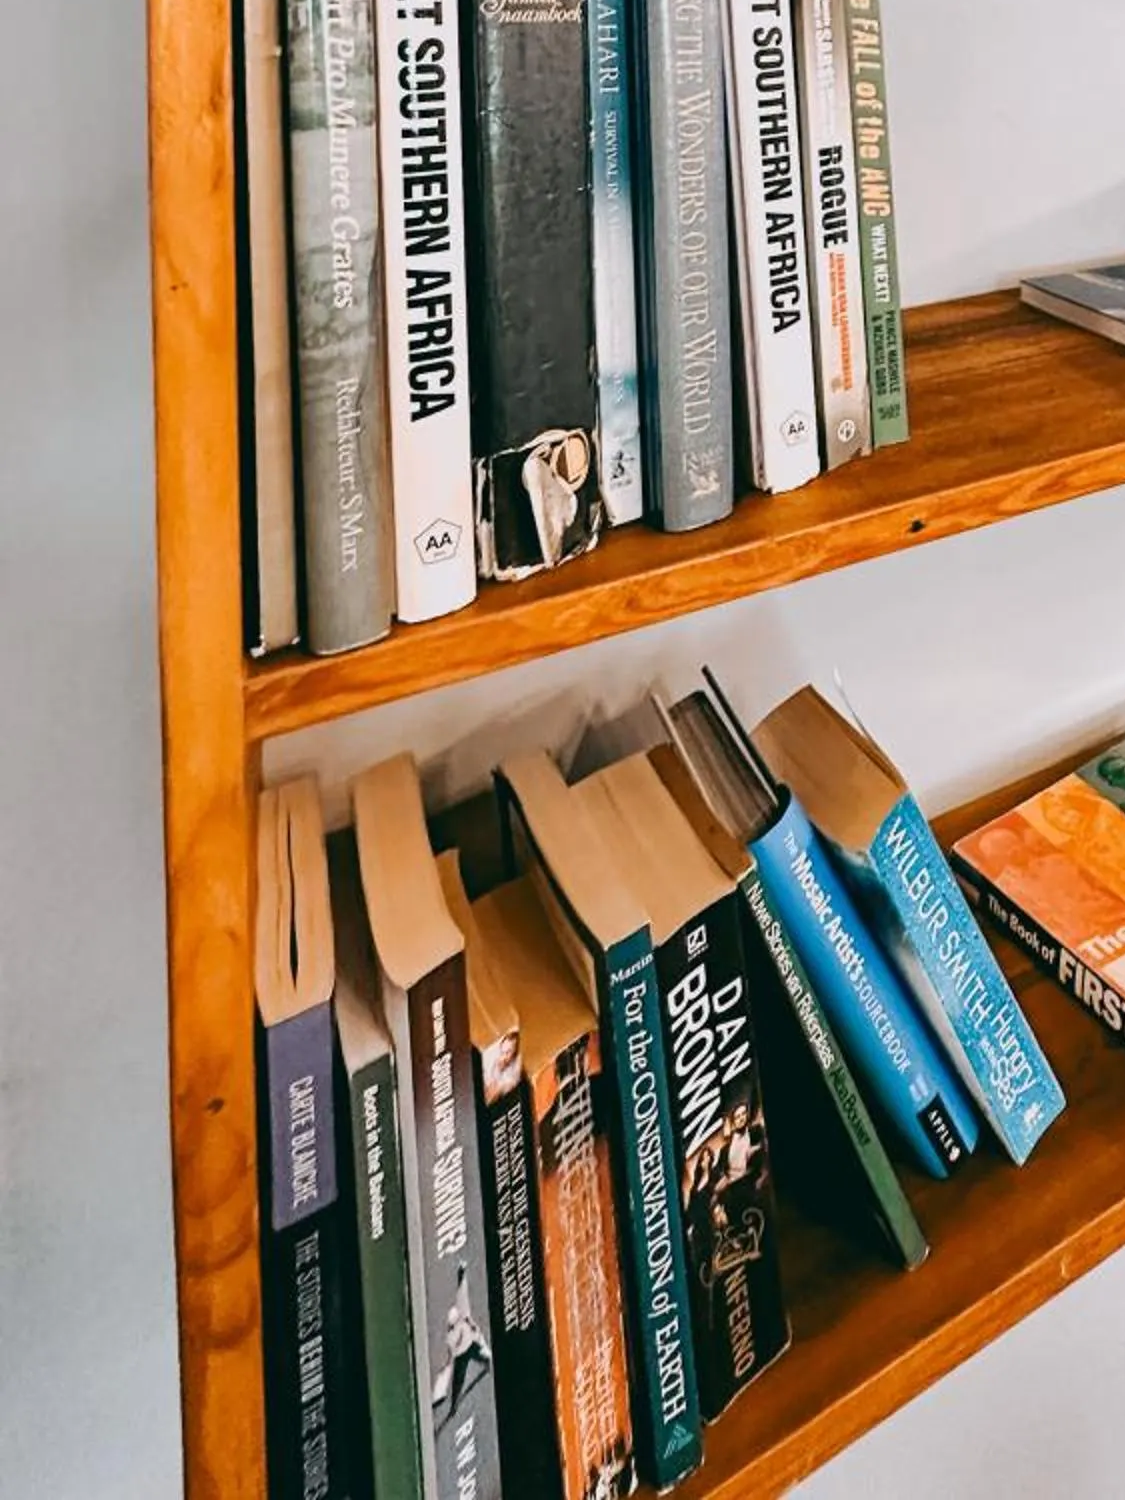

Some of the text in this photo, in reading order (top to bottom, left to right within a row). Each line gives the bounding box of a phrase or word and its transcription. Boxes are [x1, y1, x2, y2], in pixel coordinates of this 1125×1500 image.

[499, 5, 583, 24] naamboek
[326, 38, 355, 89] Pro
[675, 29, 704, 85] THE
[852, 17, 881, 75] FALL
[752, 27, 793, 203] SOUTHERN
[856, 81, 882, 110] of
[328, 97, 357, 211] Munere
[397, 36, 452, 257] SOUTHERN
[604, 110, 619, 184] SURVIVAL
[677, 88, 712, 225] WONDERS
[859, 116, 886, 159] the
[608, 184, 621, 200] IN
[818, 144, 849, 250] ROGUE
[861, 166, 891, 218] ANC
[330, 215, 361, 309] Grates
[682, 231, 707, 265] OF
[870, 222, 888, 262] WHAT
[680, 271, 709, 327] OUR
[765, 211, 802, 334] AFRICA
[405, 268, 456, 423] AFRICA
[884, 310, 899, 348] PRINCE
[681, 330, 718, 435] WORLD
[886, 349, 901, 395] MASHELE
[787, 420, 806, 437] AA
[424, 530, 453, 553] AA
[746, 882, 771, 920] Nuwe
[764, 916, 793, 975] Stories
[886, 816, 992, 1031] WILBUR SMITH
[987, 893, 1008, 923] The
[1008, 915, 1042, 956] Book
[1041, 946, 1056, 965] of
[609, 951, 655, 984] Martin
[782, 830, 913, 1077] The Mosaic Artist's SOURCEBOOK
[667, 961, 750, 1156] DAN BROWN
[989, 1001, 1038, 1097] Hungry
[431, 1052, 453, 1106] SOUTH
[990, 1058, 1018, 1112] Sea
[288, 1075, 318, 1210] CARTE BLANCHE
[366, 1128, 382, 1148] in
[433, 1097, 456, 1157] AFRICA
[927, 1109, 952, 1147] APPLE
[368, 1145, 384, 1174] the
[434, 1146, 467, 1260] SURVIVE?
[492, 1114, 519, 1332] FREDERIK VAN ZYL SLABBERT
[506, 1102, 535, 1332] DUSKANT DIE GESKIEDENIS
[624, 985, 688, 1424] For the CONSERVATION of EARTH
[295, 1230, 319, 1266] THE
[297, 1267, 323, 1340] STORIES
[299, 1335, 325, 1404] BEHIND
[301, 1398, 326, 1438] THE
[455, 1416, 475, 1445] R
[456, 1440, 476, 1470] W
